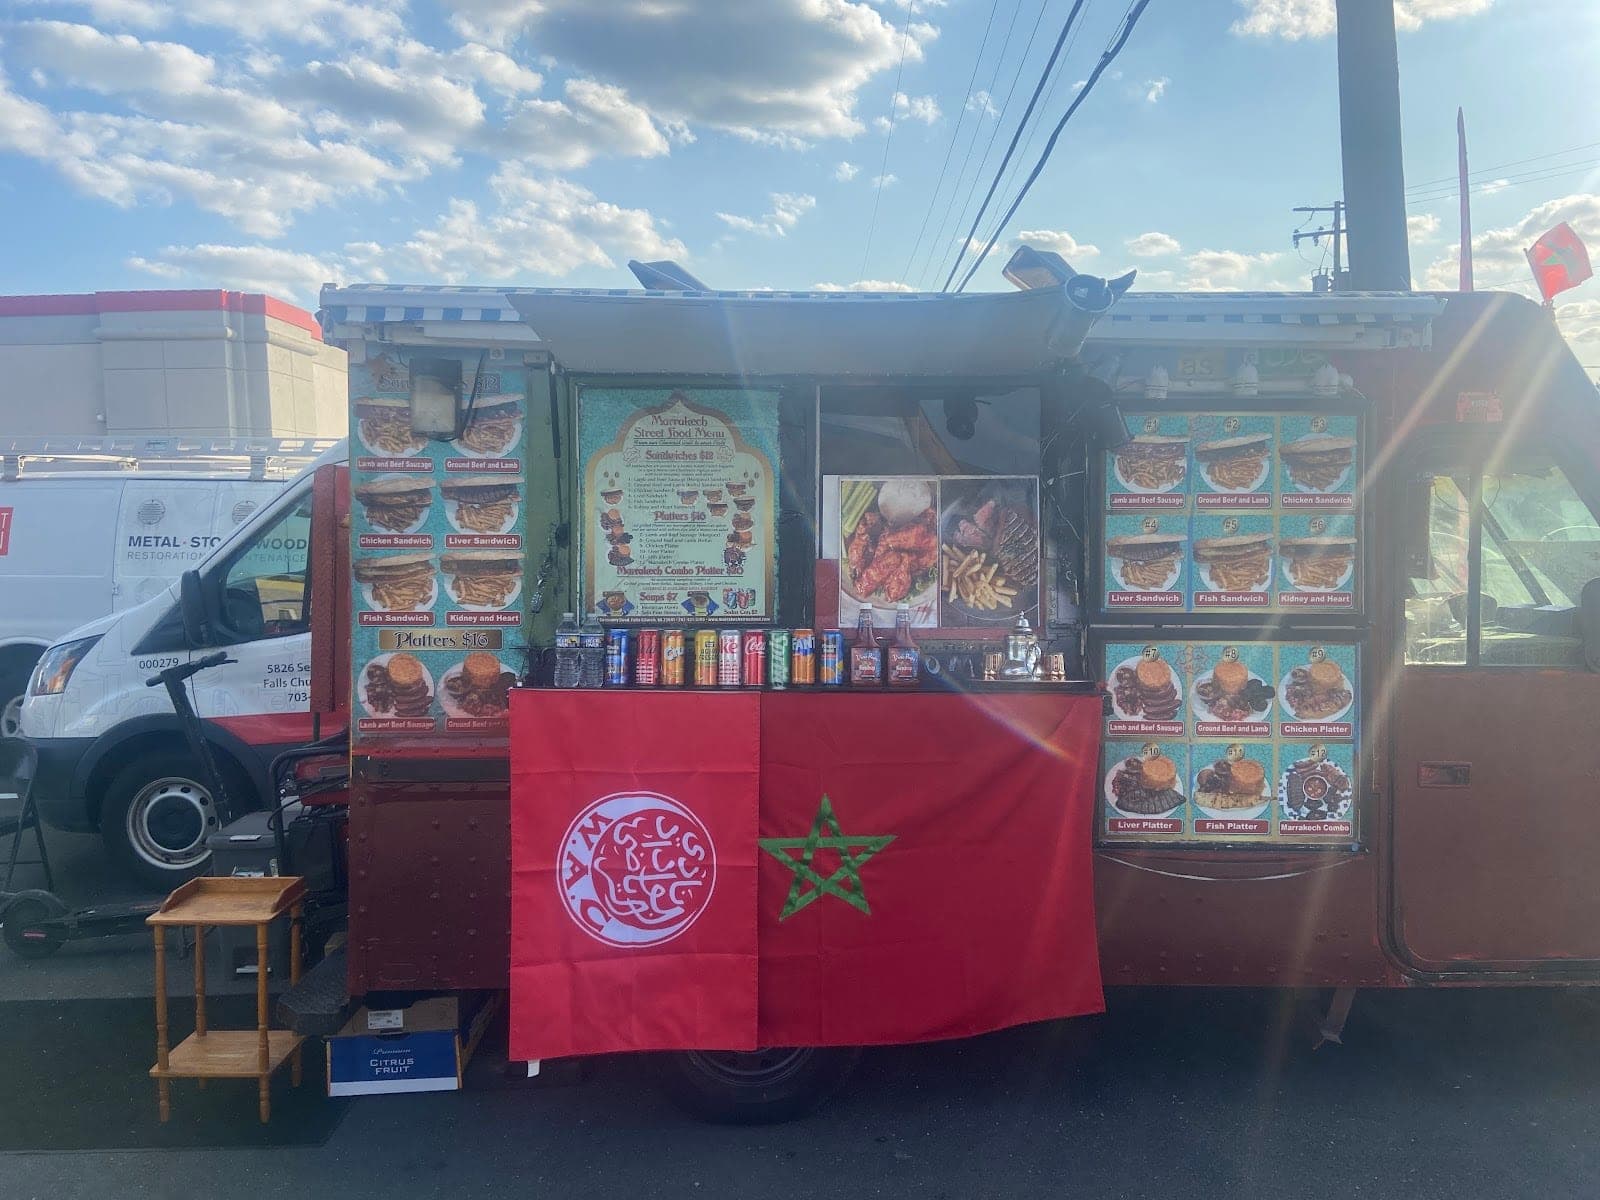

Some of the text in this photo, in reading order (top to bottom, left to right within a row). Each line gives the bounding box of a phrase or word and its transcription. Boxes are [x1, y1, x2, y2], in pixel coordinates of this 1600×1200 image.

[1226, 419, 1238, 429] #2
[1313, 419, 1325, 429] #3
[634, 427, 725, 438] Street Food Menu
[646, 450, 697, 461] Sandwiches
[447, 461, 518, 469] Ground Beef and Lamb
[1156, 497, 1183, 505] Sausage
[1198, 497, 1269, 505] Ground Beef and Lamb
[1283, 496, 1352, 505] Chicken Sandwich
[1144, 520, 1156, 530] #4
[1225, 520, 1237, 530] #5
[1312, 520, 1324, 530] #6
[129, 535, 180, 548] METAL
[360, 537, 431, 545] Chicken Sandwich
[449, 537, 517, 545] Liver Sandwich
[616, 566, 663, 576] Marrakech
[665, 566, 694, 576] Combo
[695, 566, 726, 576] Platter
[640, 591, 665, 603] Soups
[1111, 595, 1179, 603] Liver Sandwich
[1199, 595, 1264, 603] Fish Sandwich
[1281, 595, 1350, 604] Kidney and Heart
[450, 615, 519, 623] Kidney and Heart
[394, 632, 489, 649] Platters $16
[1145, 648, 1157, 658] #7
[1225, 648, 1237, 659] #8
[1312, 649, 1324, 659] #9
[139, 657, 180, 670] 000279
[267, 663, 295, 673] 5826
[264, 678, 287, 689] Falls
[1110, 725, 1183, 733] Lamb and Beef Sausage
[1198, 725, 1269, 734] Ground Beef and Lamb
[1284, 725, 1348, 734] Chicken Platter
[1118, 822, 1173, 830] Liver Platter
[1206, 822, 1258, 831] Fish Platter
[1323, 824, 1350, 832] Combo
[370, 1057, 415, 1067] CITRUS
[375, 1066, 410, 1075] FRUIT
